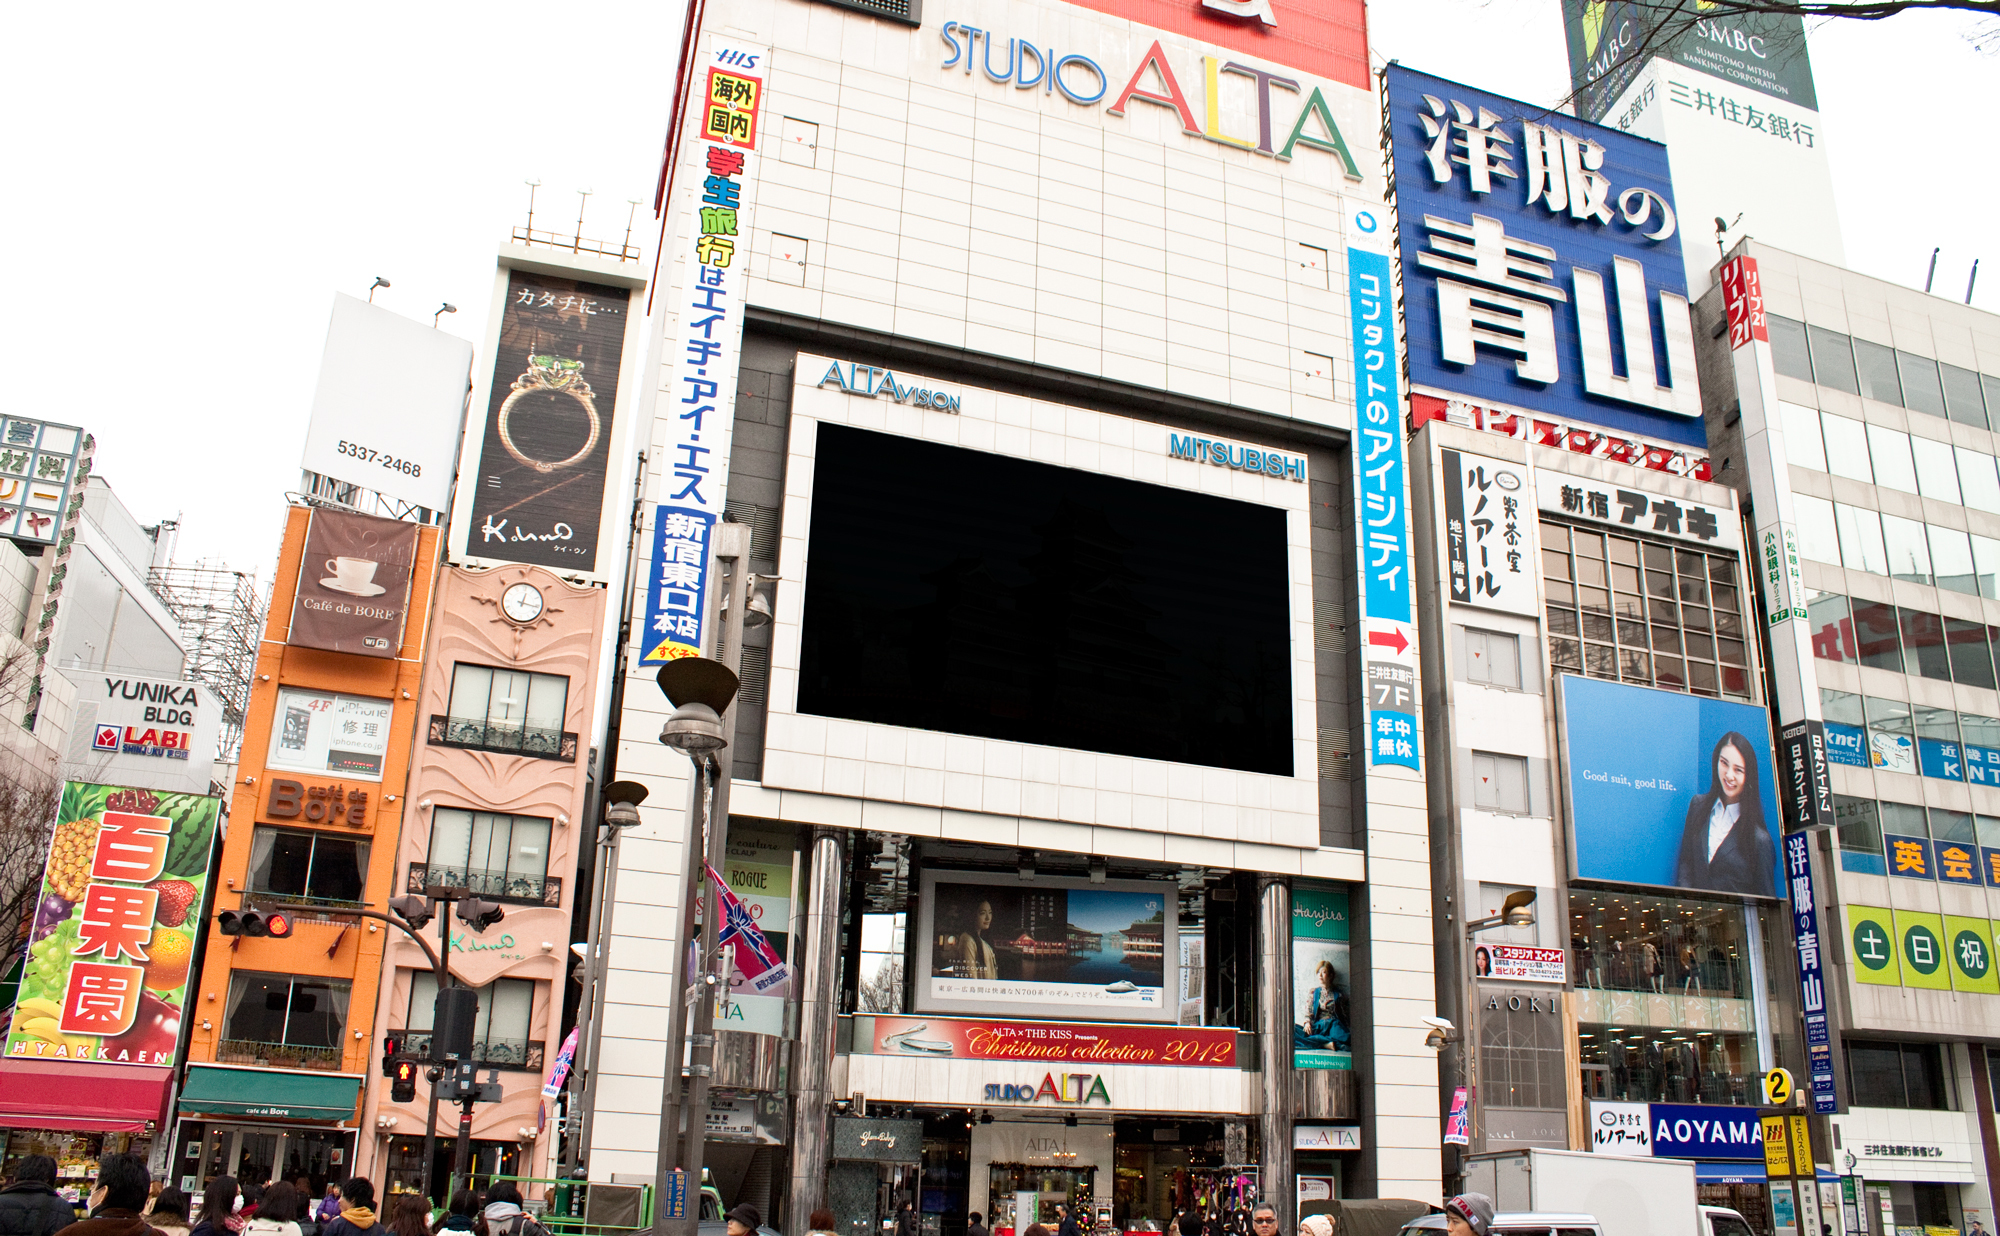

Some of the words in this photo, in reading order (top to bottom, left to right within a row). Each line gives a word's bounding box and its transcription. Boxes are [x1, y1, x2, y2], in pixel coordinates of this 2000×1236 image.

[1696, 17, 1766, 59] SMBC
[1683, 52, 1724, 74] BANKING
[1727, 67, 1789, 96] CORPORATION
[1695, 46, 1745, 69] SUMITOMO
[1747, 62, 1776, 81] MITSUI
[714, 76, 752, 106] 海外
[941, 21, 1107, 106] STUDIO
[1106, 38, 1364, 182] ALTA
[710, 109, 749, 138] 国内
[1668, 80, 1815, 149] 三井住友銀行
[1418, 93, 1677, 242] 洋服の
[1416, 213, 1703, 418] 青山
[338, 440, 421, 478] 5337-2468
[1168, 433, 1307, 482] MITSUBISHI
[1560, 484, 1610, 520] 新宿
[1617, 488, 1719, 541] アオキ
[1468, 466, 1502, 598] ルノアール
[1503, 495, 1522, 574] 喫茶室
[304, 598, 328, 613] Café
[331, 602, 351, 615] de
[354, 606, 395, 621] BORE
[1773, 609, 1787, 622] 7F
[653, 612, 699, 639] 本店
[1368, 666, 1413, 685] 三井住友銀行
[105, 678, 198, 707] YUNIKA
[308, 699, 332, 713] 4F
[1374, 684, 1410, 706] 7F
[144, 706, 195, 727] BLDG.
[342, 719, 379, 737] 修理
[1377, 717, 1411, 737] 年中
[122, 744, 164, 758] SHINJUKU
[123, 726, 192, 750] LABI
[1378, 738, 1413, 758] 無休
[1583, 769, 1608, 782] Good
[1611, 773, 1631, 787] suit,
[1634, 777, 1656, 790] good
[1659, 779, 1677, 791] life.
[1791, 743, 1810, 822] 日本ケイテム
[1812, 734, 1831, 812] 日本ケイテム
[732, 870, 768, 890] ROGUE
[57, 811, 173, 1037] 百果園
[1788, 837, 1824, 1012] 洋服の青山
[1861, 929, 1886, 960] 土
[1911, 934, 1935, 965] 日
[1959, 938, 1984, 970] 祝
[1517, 968, 1527, 977] 2F
[1487, 995, 1557, 1013] AOKI
[966, 1027, 1067, 1060] Christmas
[1071, 1041, 1156, 1061] collection
[1161, 1040, 1232, 1062] 2012
[991, 1027, 1017, 1038] ALTA
[1025, 1029, 1047, 1039] THE
[1049, 1030, 1072, 1040] KISS
[13, 1041, 167, 1064] HYAKKAEN
[984, 1083, 1035, 1101] STUDIO
[1034, 1072, 1111, 1104] ALTA
[1769, 1071, 1786, 1099] 2
[1025, 1138, 1060, 1152] ALTA
[1317, 1129, 1355, 1146] ALTA
[1594, 1128, 1648, 1146] ルノアール
[1655, 1119, 1763, 1144] AOYAMA
[1768, 1156, 1788, 1165] はとバス
[1864, 1144, 1943, 1158] 三井住友銀行新宿ビル
